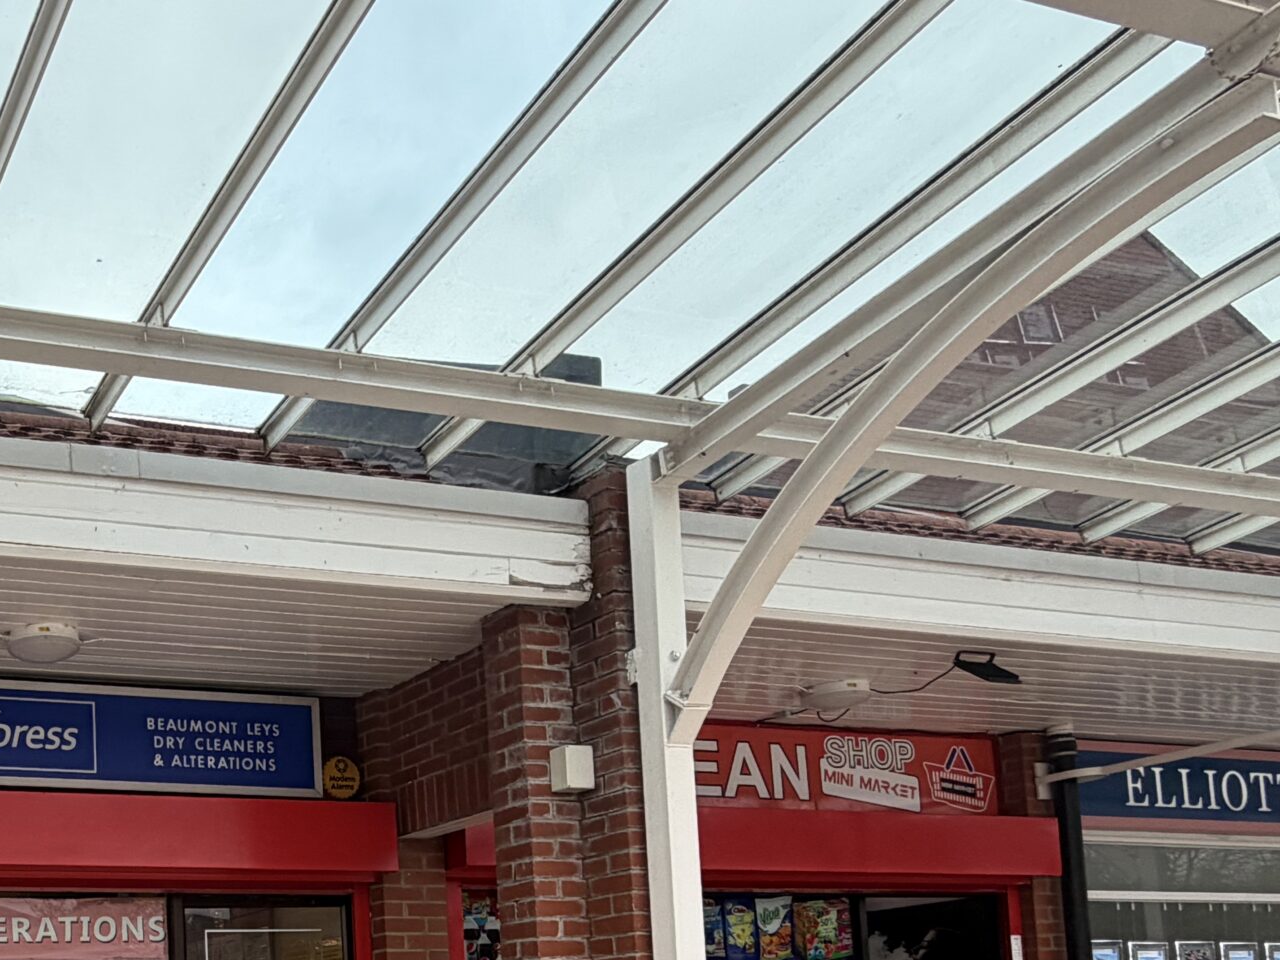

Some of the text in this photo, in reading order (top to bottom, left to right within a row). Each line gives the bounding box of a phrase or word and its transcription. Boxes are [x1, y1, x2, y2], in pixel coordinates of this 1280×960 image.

[146, 717, 280, 736] BEAUMONT LEYS
[154, 736, 275, 753] DRY CLEANERS
[824, 735, 915, 772] SHOP
[154, 754, 276, 771] & ALTERATIONS
[331, 783, 355, 791] Alarms
[823, 769, 853, 788] MINI
[860, 775, 917, 799] MARKET
[1126, 766, 1280, 812] ELLIOT
